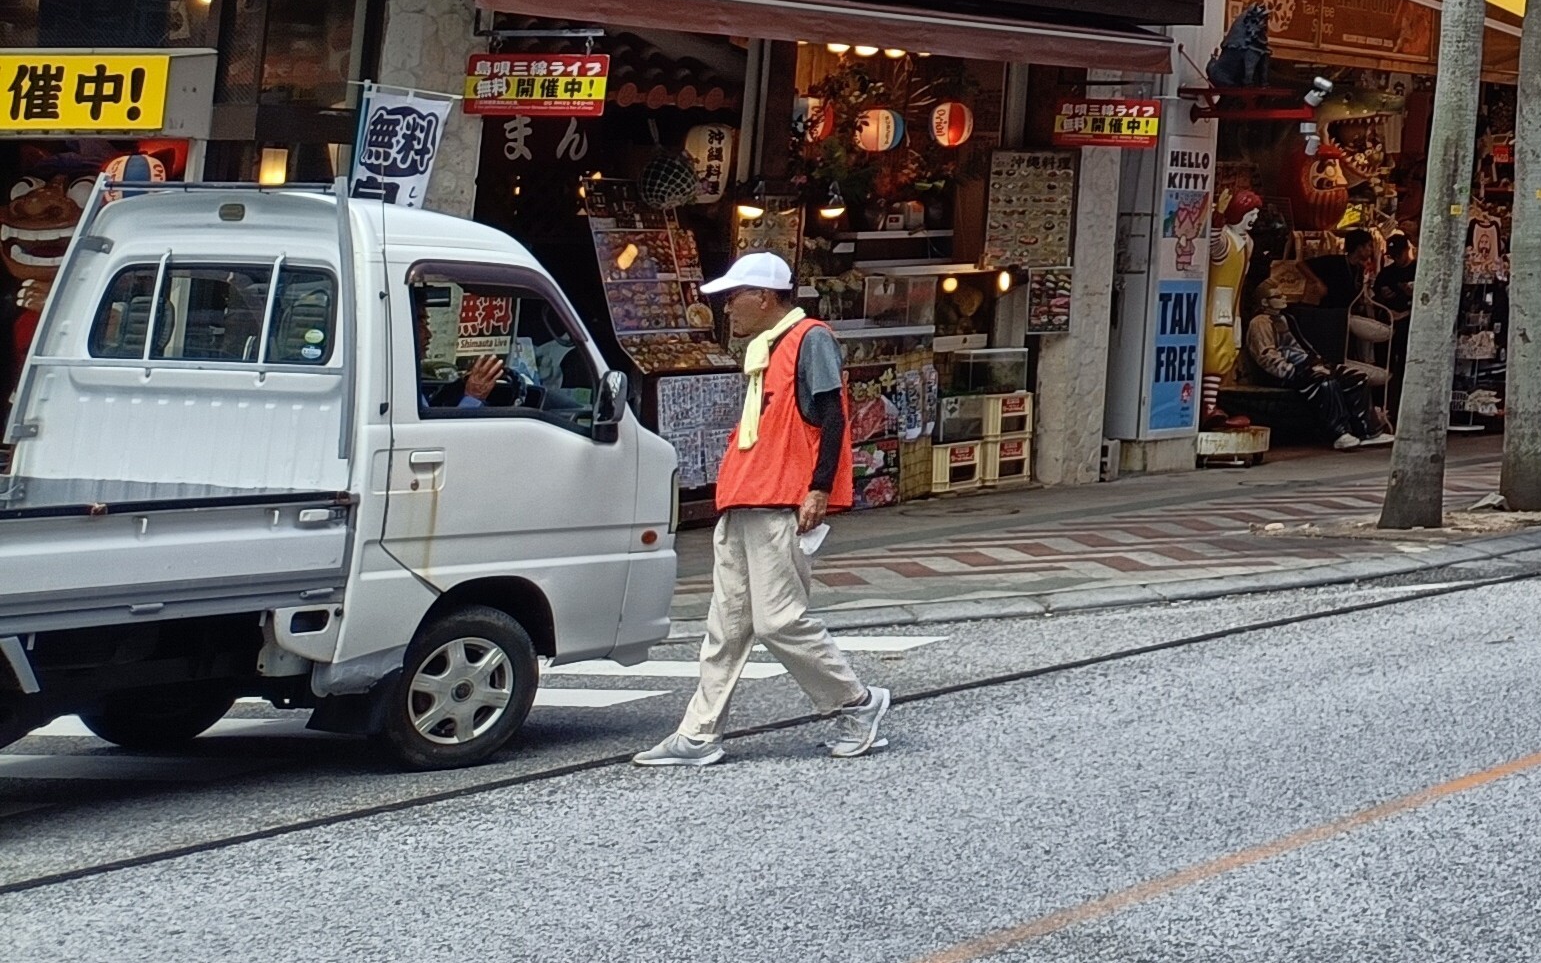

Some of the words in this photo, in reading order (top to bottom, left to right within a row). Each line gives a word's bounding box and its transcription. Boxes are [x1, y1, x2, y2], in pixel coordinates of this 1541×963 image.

[474, 60, 602, 77] 島唄三線ライブ
[8, 63, 146, 122] 催中!
[474, 77, 510, 98] 無料
[514, 77, 596, 99] 開催中!
[1060, 102, 1155, 118] 島唄三線ライブ
[1090, 118, 1150, 135] 開催中!
[361, 109, 437, 171] 無料
[504, 115, 589, 162] まん
[1170, 150, 1210, 169] HELLO
[1167, 172, 1210, 190] KITTY
[1158, 292, 1198, 335] TAX
[460, 338, 494, 348] Shimauta
[494, 338, 508, 348] Live
[1154, 346, 1196, 384] FREE
